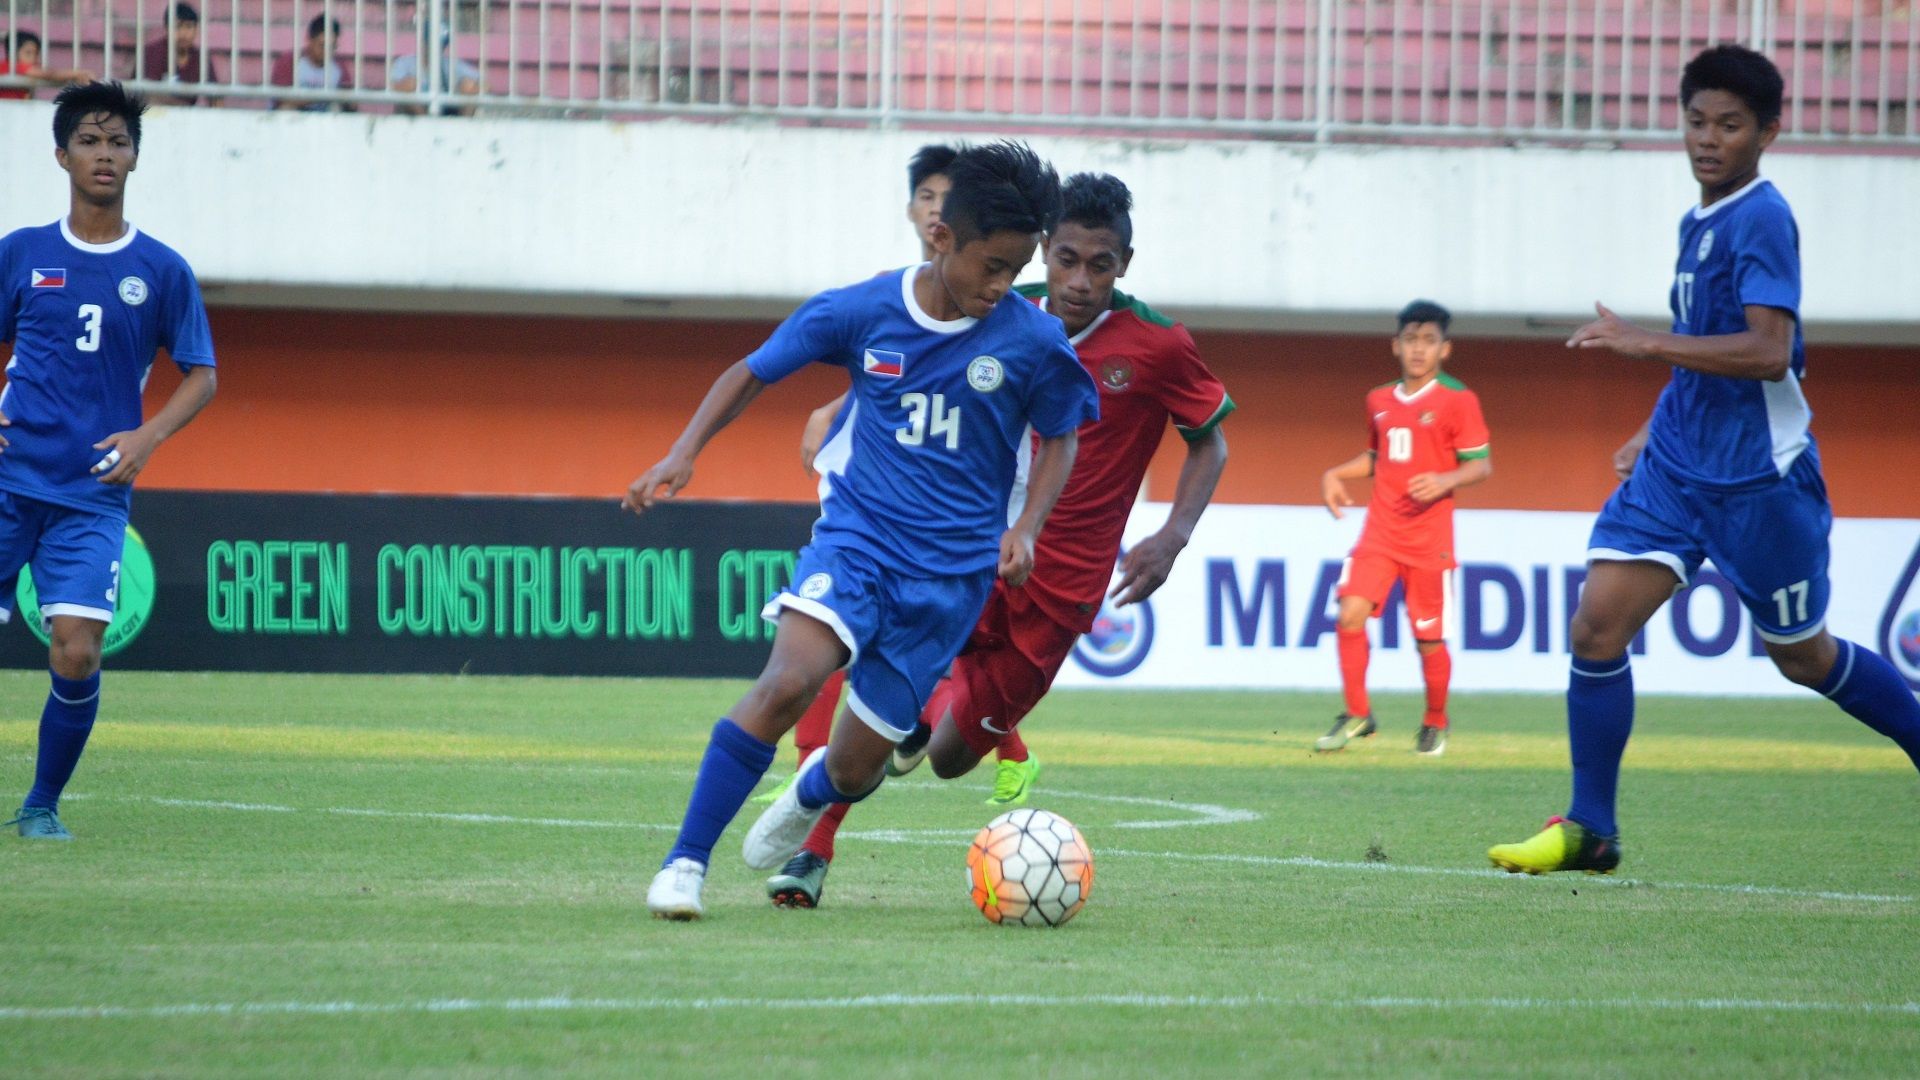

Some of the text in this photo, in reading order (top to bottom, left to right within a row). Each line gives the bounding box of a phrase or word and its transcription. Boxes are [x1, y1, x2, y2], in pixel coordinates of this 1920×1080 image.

[75, 303, 103, 352] 3
[895, 392, 961, 450] 34
[1386, 426, 1413, 463] 10
[105, 560, 120, 603] 3
[206, 540, 348, 633] GREEN
[376, 543, 692, 638] CONSTRUCTION
[1771, 579, 1809, 627] 17
